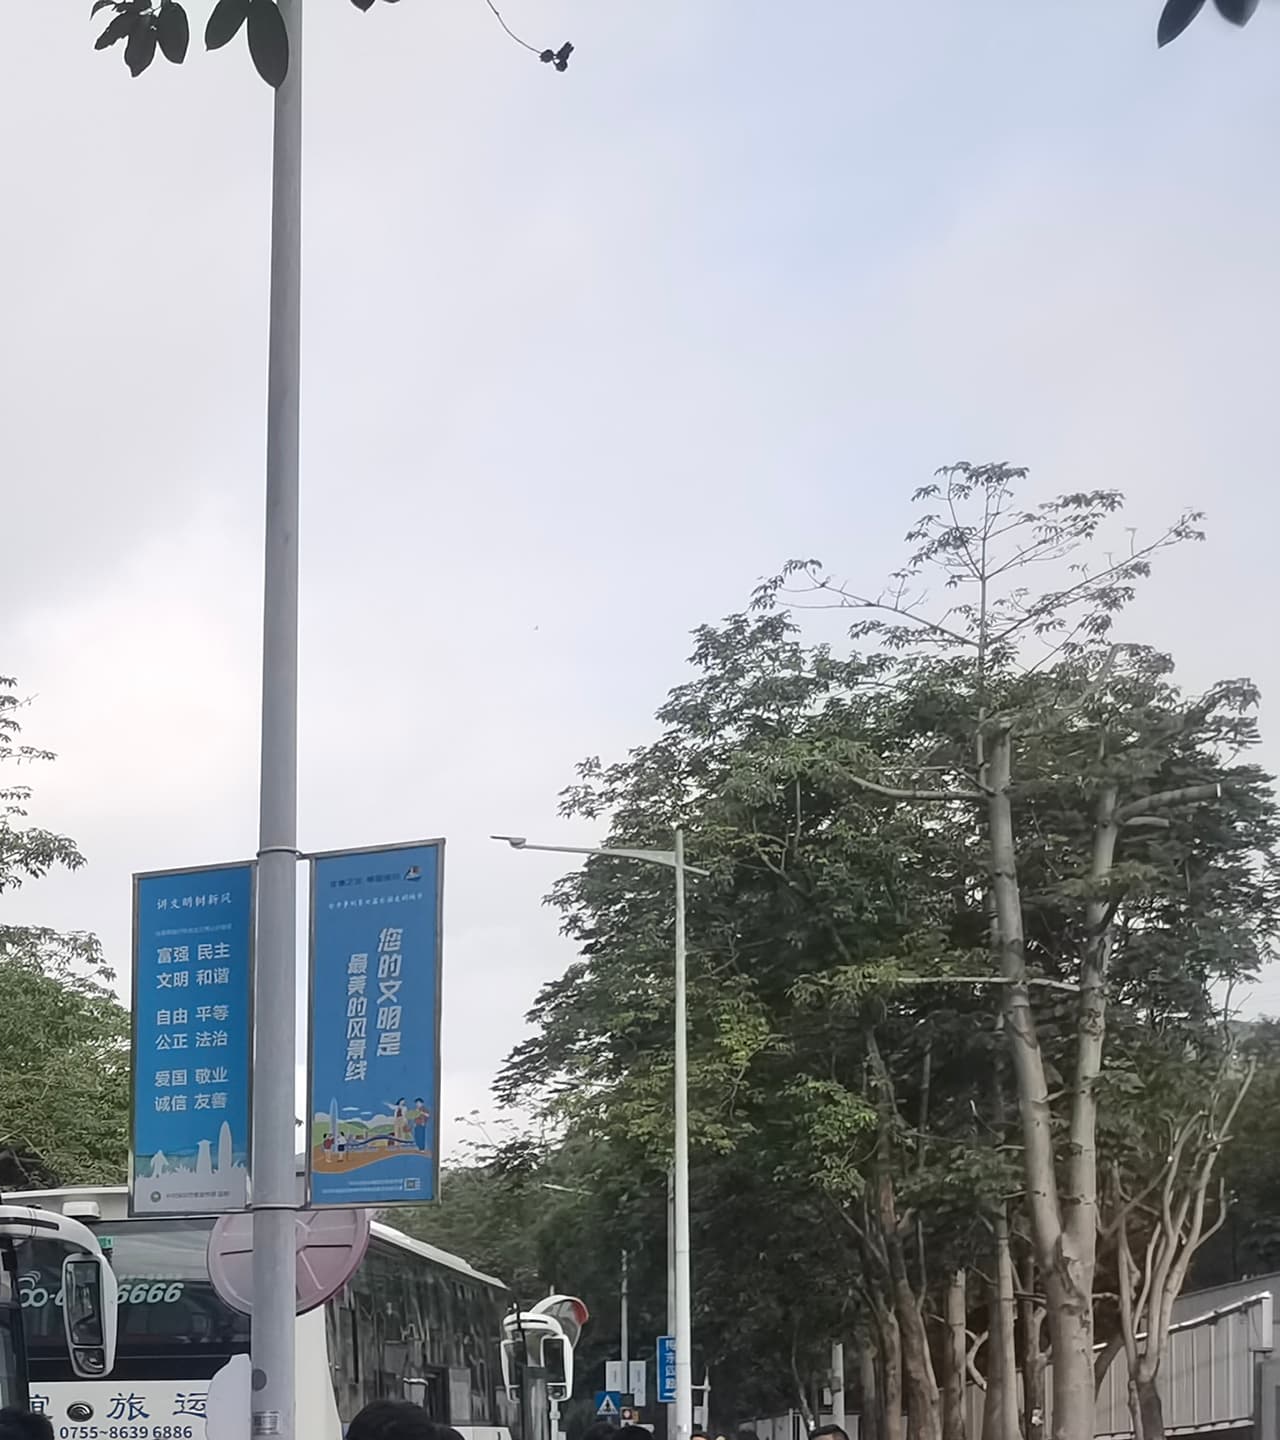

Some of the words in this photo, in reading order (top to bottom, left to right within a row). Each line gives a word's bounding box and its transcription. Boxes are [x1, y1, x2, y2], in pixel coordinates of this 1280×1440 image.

[156, 945, 189, 965] 富强
[197, 941, 230, 961] 民主
[155, 970, 189, 990] 文明
[196, 967, 230, 987] 和谐
[376, 927, 403, 1057] 您的文明是
[156, 1007, 188, 1026] 自由
[194, 1004, 229, 1022] 平等
[344, 952, 368, 1081] 最美的风景线
[154, 1032, 189, 1051] 公正
[194, 1029, 228, 1048] 法治
[154, 1068, 188, 1088] 爱国
[194, 1065, 229, 1085] 敬业
[154, 1094, 188, 1113] 诚信
[193, 1092, 228, 1111] 友善
[152, 1426, 193, 1439] 6886
